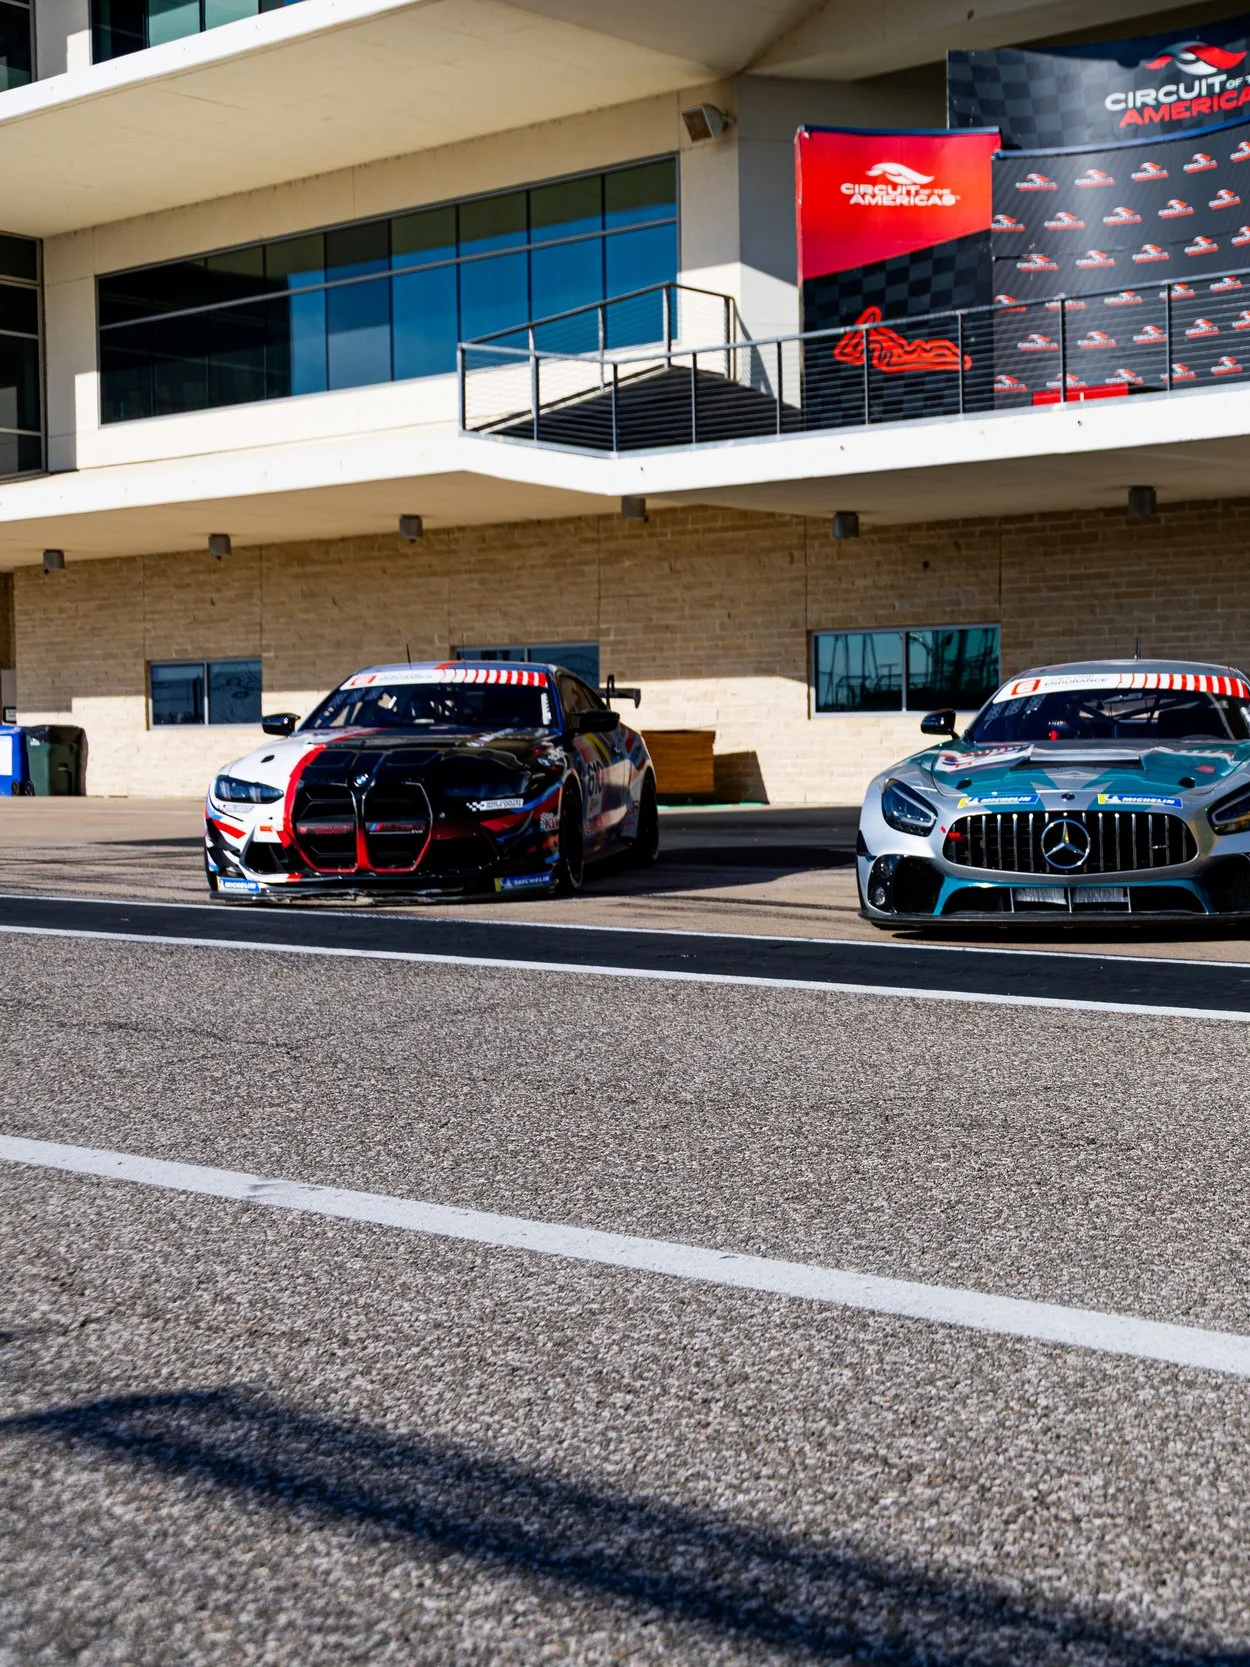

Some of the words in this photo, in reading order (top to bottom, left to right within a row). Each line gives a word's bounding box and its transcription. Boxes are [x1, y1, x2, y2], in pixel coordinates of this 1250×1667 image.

[1104, 73, 1227, 111] CIRCUIT
[1225, 76, 1243, 90] OF
[840, 182, 920, 196] CIRCUIT
[849, 194, 956, 206] AMERICAS
[980, 796, 1032, 804] MICHELIN
[1122, 796, 1175, 804] MICHELIN
